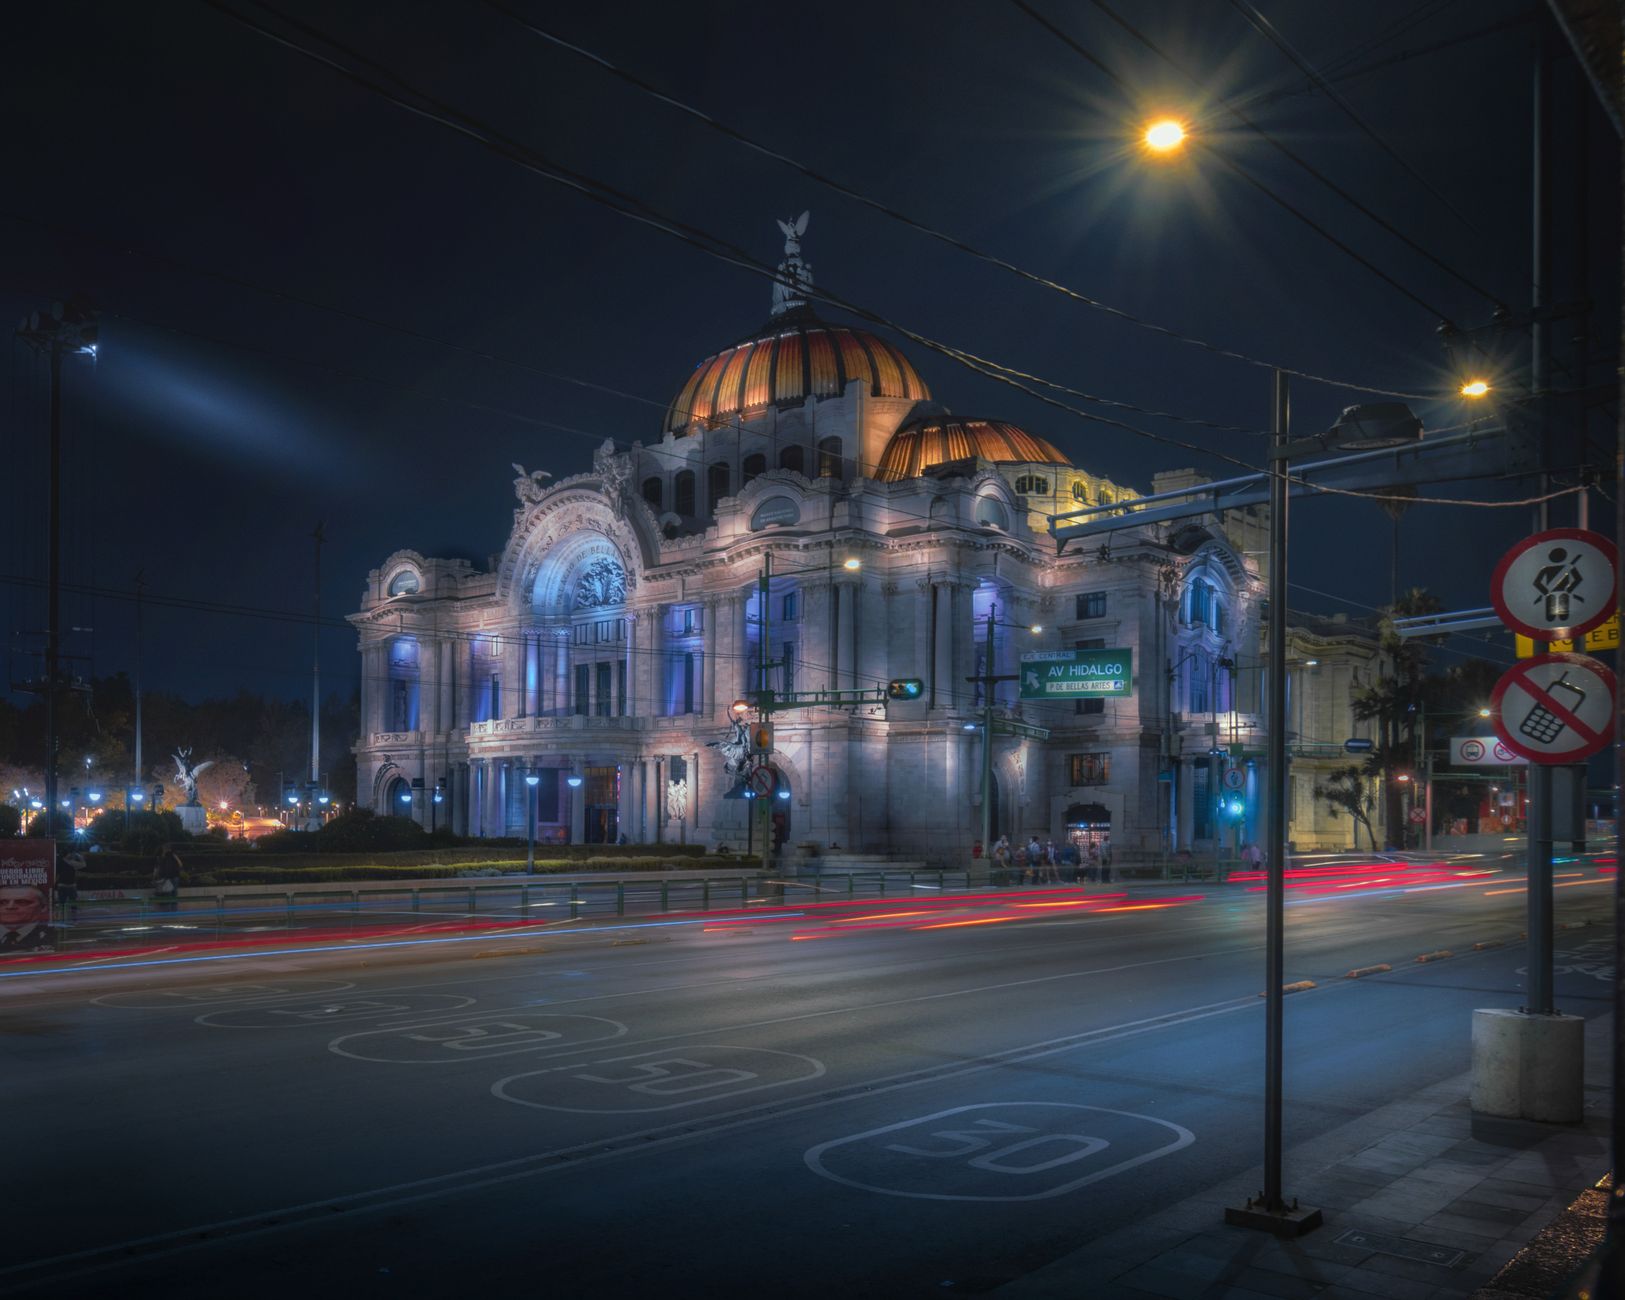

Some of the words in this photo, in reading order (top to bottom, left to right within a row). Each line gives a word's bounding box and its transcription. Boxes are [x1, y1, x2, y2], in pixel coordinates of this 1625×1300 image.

[576, 550, 588, 562] DE
[1048, 665, 1065, 677] AV
[1069, 663, 1122, 676] HIDALGO
[1055, 683, 1064, 691] DE
[1066, 682, 1089, 690] BELLAS
[1091, 681, 1111, 690] ARTES
[408, 1022, 562, 1050] 50
[575, 1057, 759, 1096] 50
[884, 1118, 1111, 1175] 30
